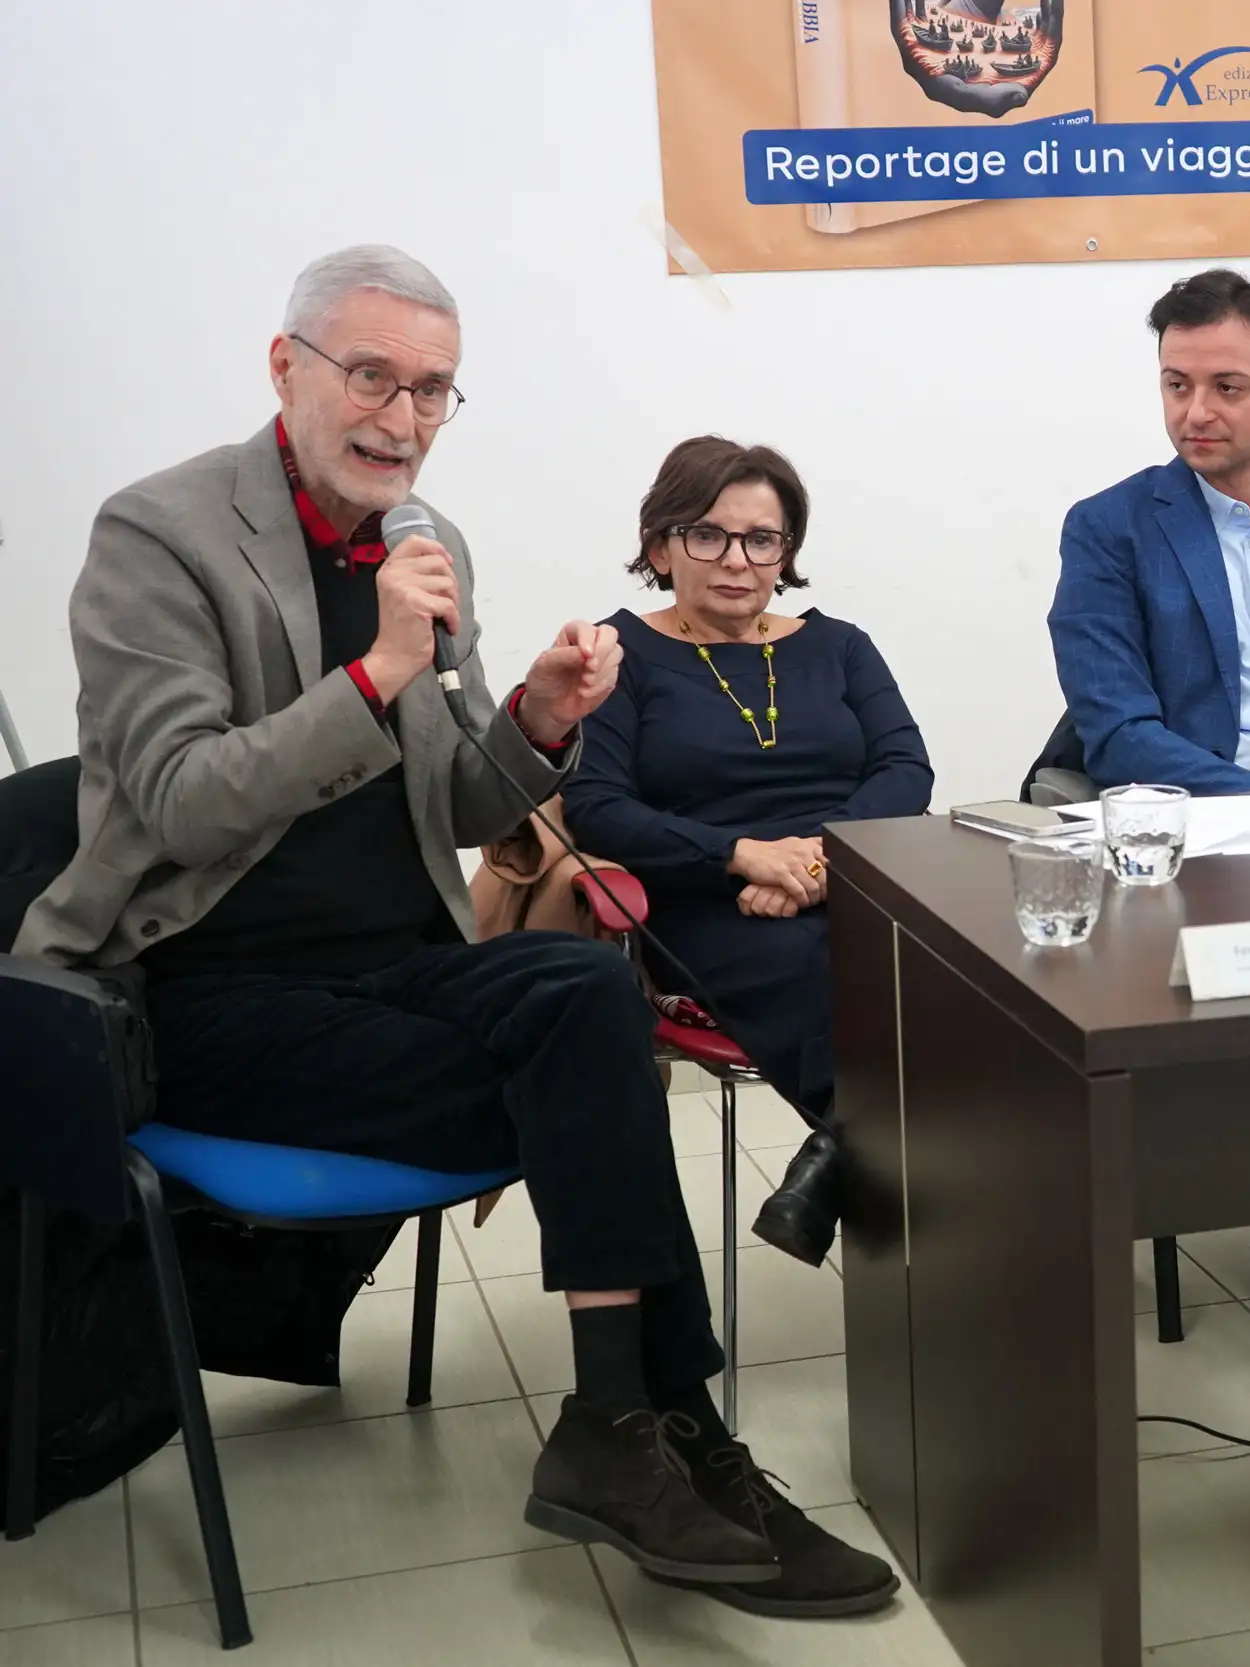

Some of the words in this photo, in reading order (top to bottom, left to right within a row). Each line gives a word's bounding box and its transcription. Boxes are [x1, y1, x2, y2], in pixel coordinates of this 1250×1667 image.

[766, 145, 1006, 187] Reportage
[1023, 141, 1058, 174] di
[1075, 143, 1125, 173] un
